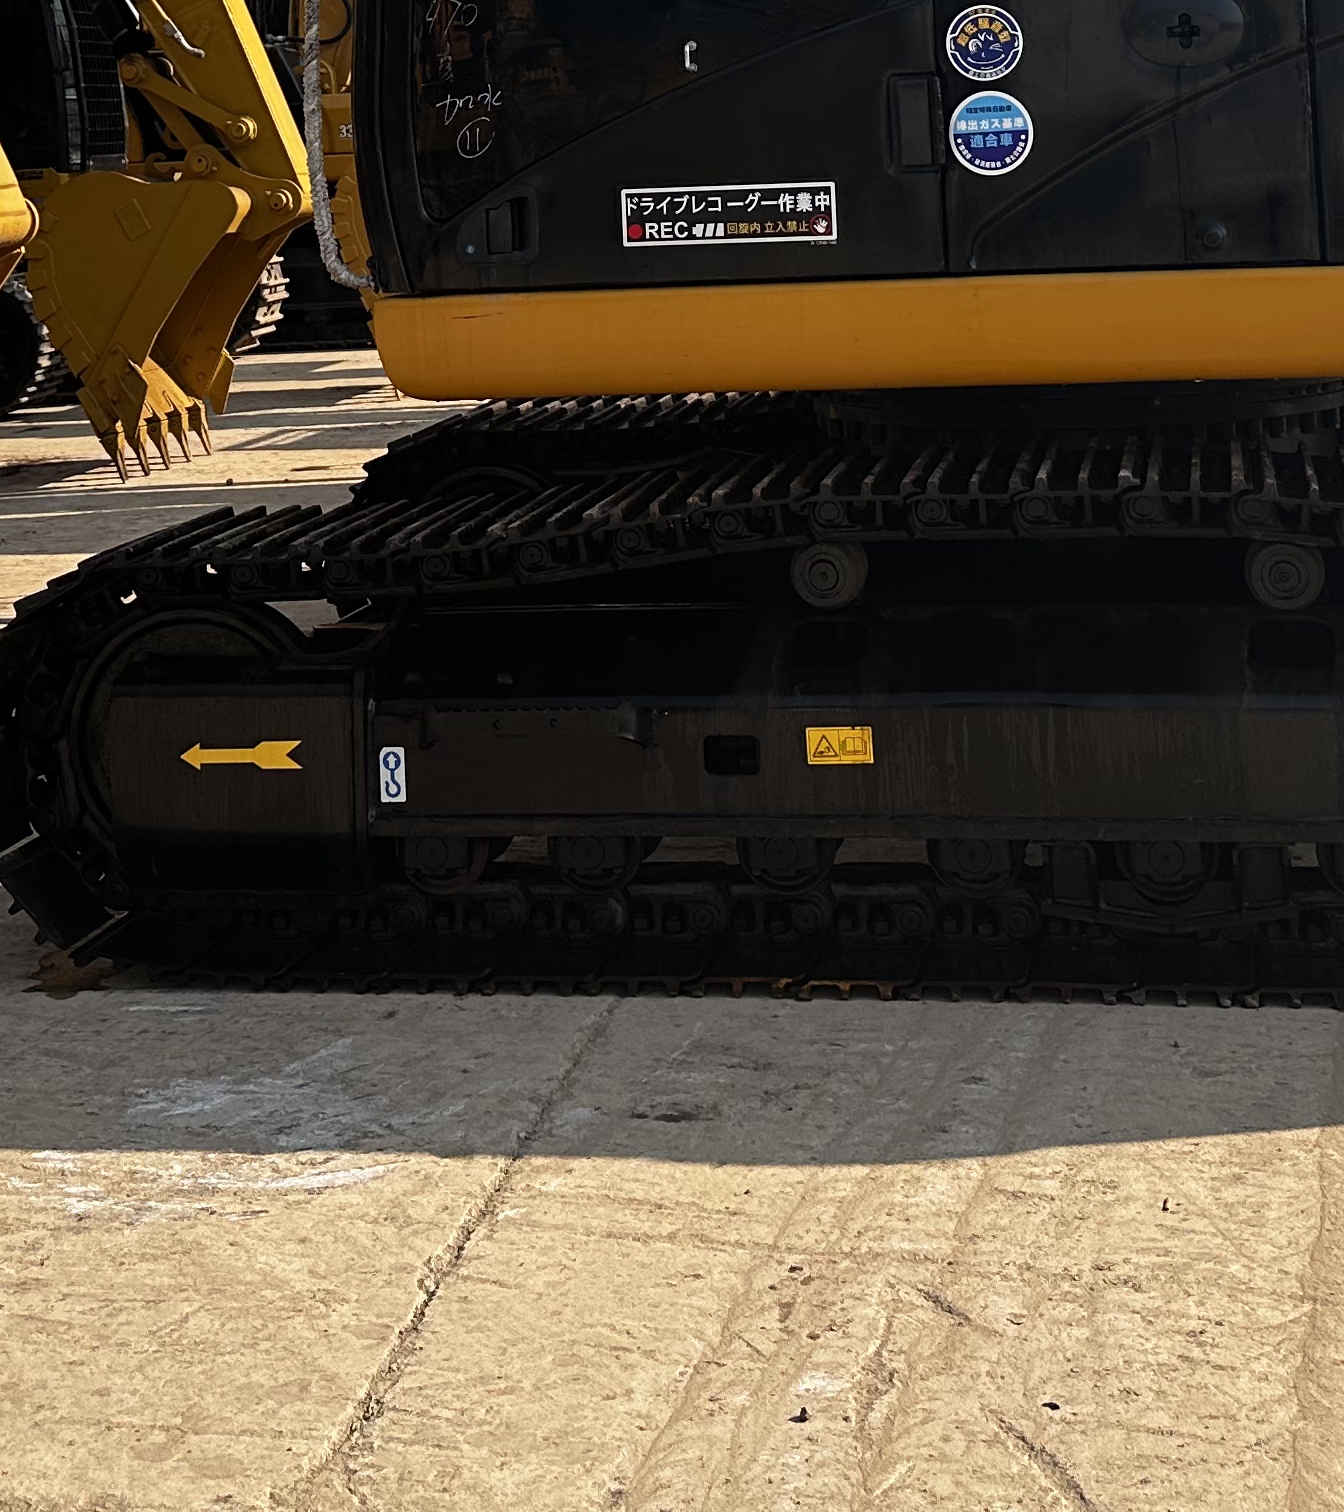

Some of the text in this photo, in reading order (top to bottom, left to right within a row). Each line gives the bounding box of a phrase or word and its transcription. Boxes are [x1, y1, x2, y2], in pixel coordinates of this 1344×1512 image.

[970, 133, 1014, 148] 適合車
[645, 221, 689, 239] REC
